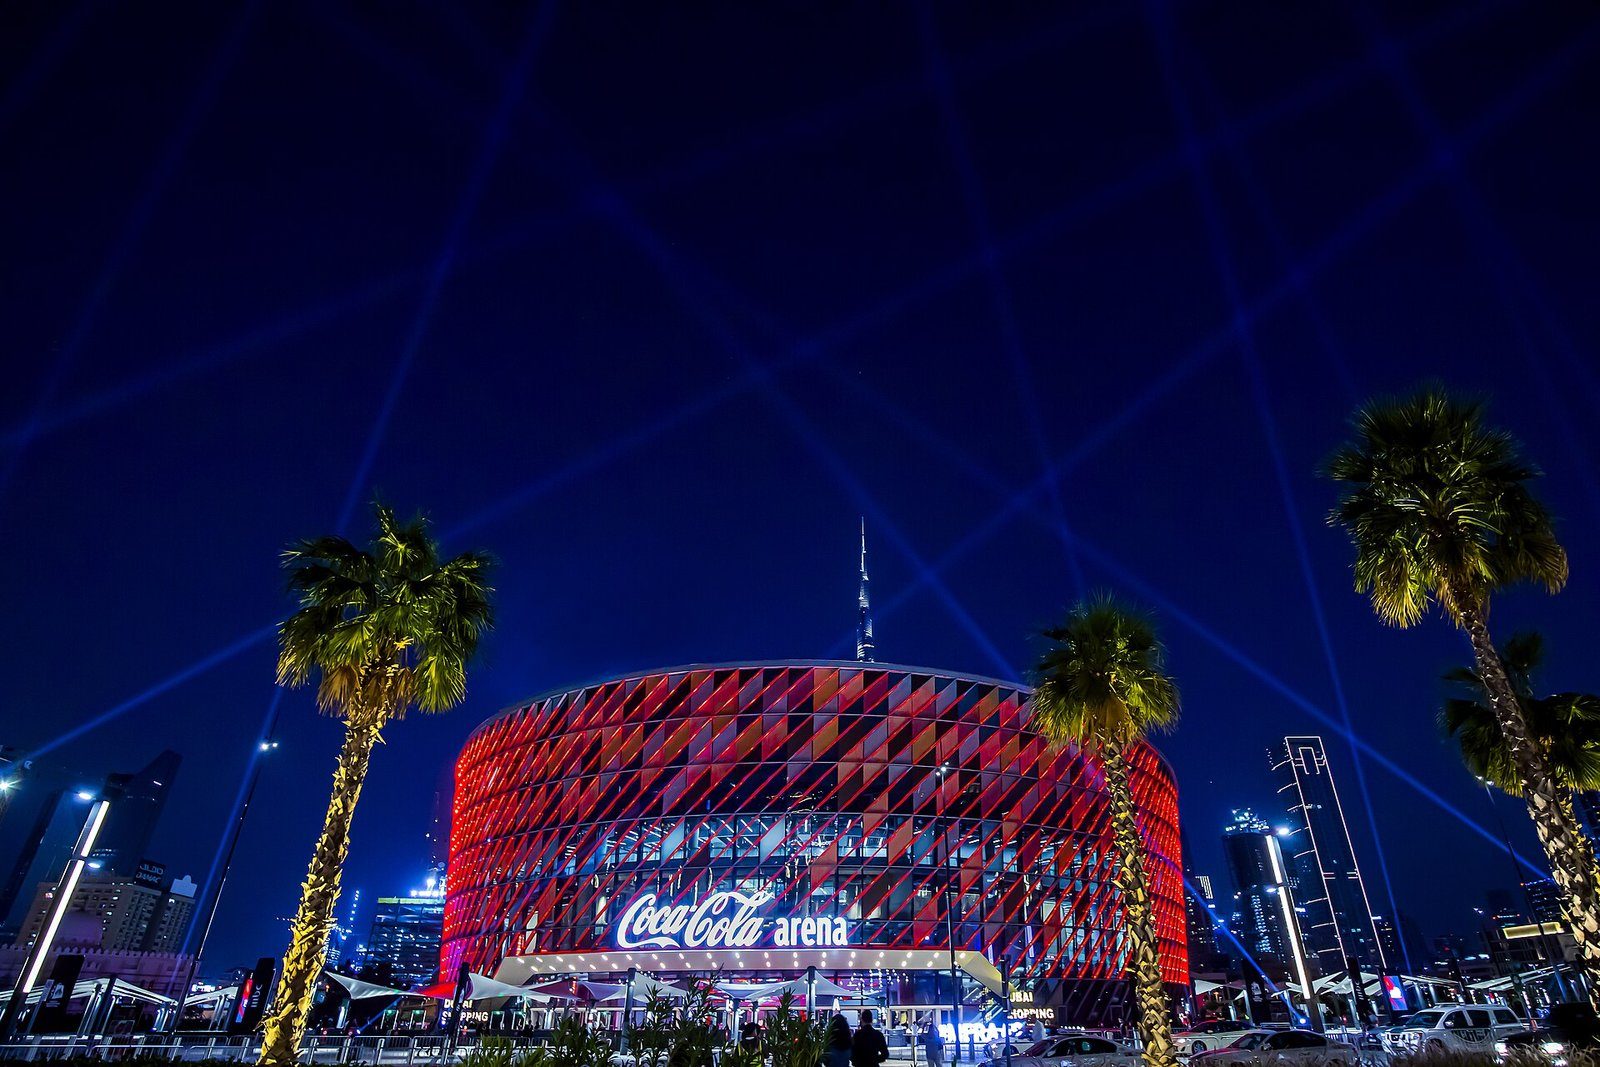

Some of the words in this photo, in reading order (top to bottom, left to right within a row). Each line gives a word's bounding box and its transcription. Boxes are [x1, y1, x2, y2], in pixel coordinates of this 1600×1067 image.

[617, 891, 776, 949] Coca-Cola
[774, 916, 848, 947] arena
[1009, 991, 1034, 1003] UBAI
[443, 999, 473, 1008] DAI
[442, 1011, 489, 1021] SPPING
